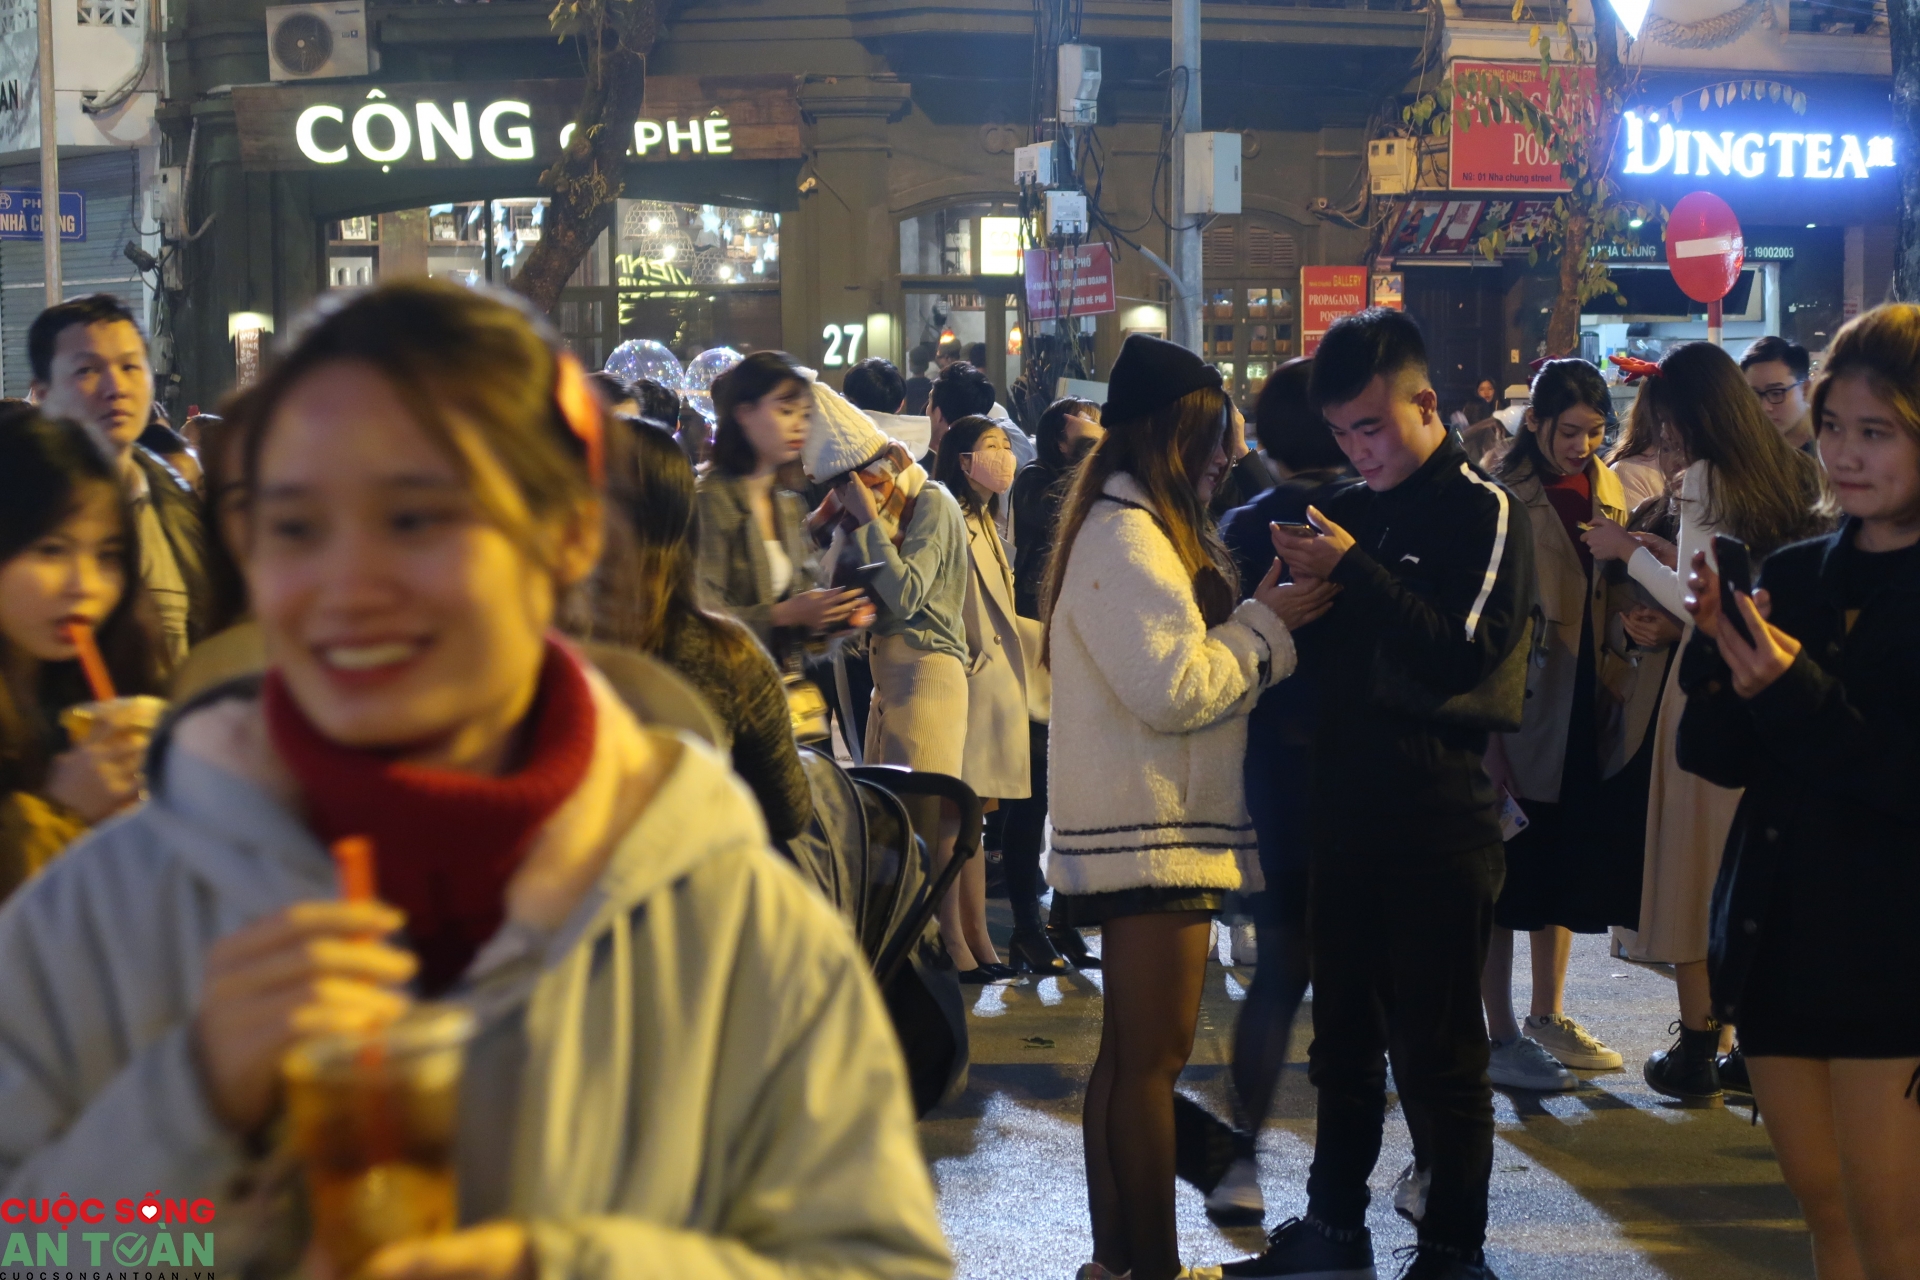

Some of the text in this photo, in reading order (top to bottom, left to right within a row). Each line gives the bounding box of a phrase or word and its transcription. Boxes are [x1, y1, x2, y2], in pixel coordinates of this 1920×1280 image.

[1506, 70, 1536, 83] GALLERY
[296, 88, 534, 173] CỘNG
[634, 109, 733, 156] PHÊ
[1488, 173, 1504, 181] Nha
[1505, 173, 1529, 184] chung
[22, 198, 42, 209] PH
[0, 210, 76, 233] NHÀ CNG
[1754, 246, 1794, 258] 19002003
[1333, 275, 1362, 287] GALLERY
[1308, 294, 1360, 306] PROPAGANDA
[822, 323, 864, 366] 27
